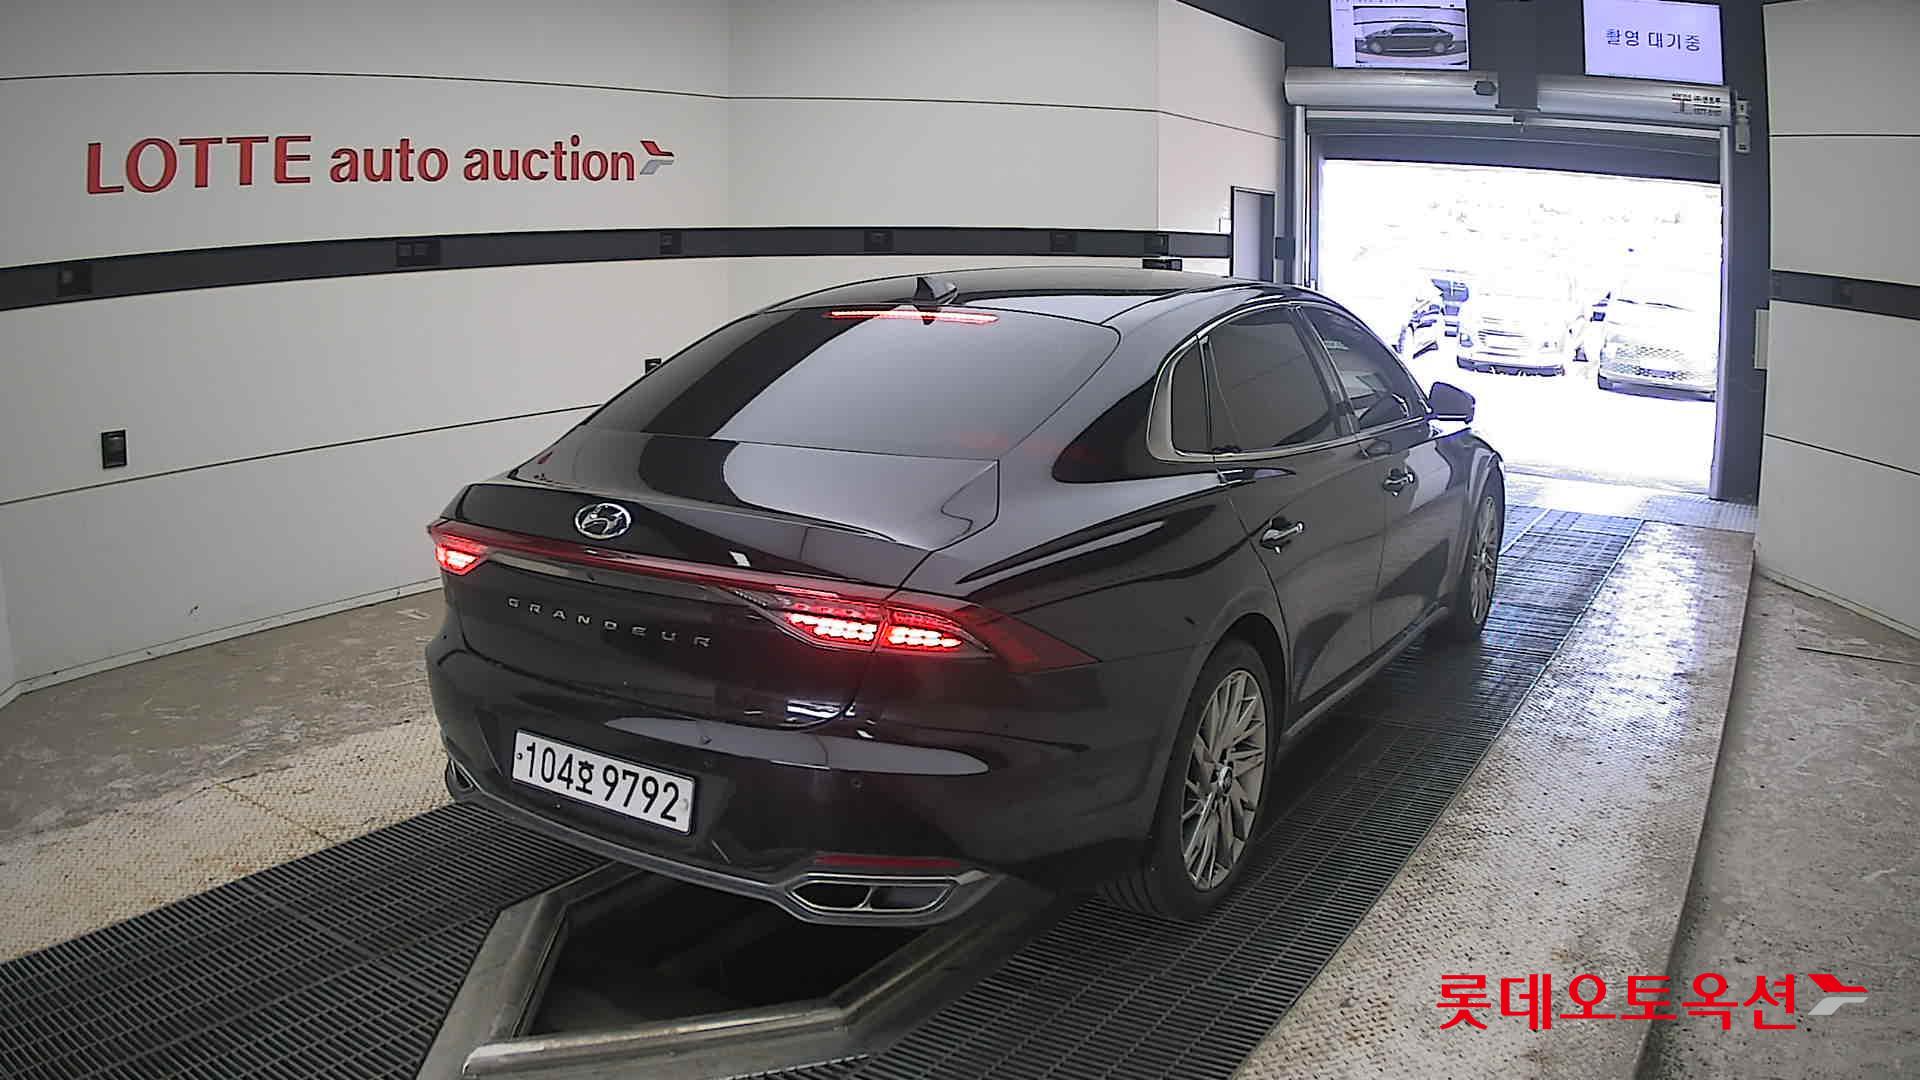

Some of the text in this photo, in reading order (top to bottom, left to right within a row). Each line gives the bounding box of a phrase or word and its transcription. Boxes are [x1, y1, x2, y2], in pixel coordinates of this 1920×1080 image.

[87, 134, 636, 194] LOTTE auto auction
[507, 597, 713, 648] GRANDEUR
